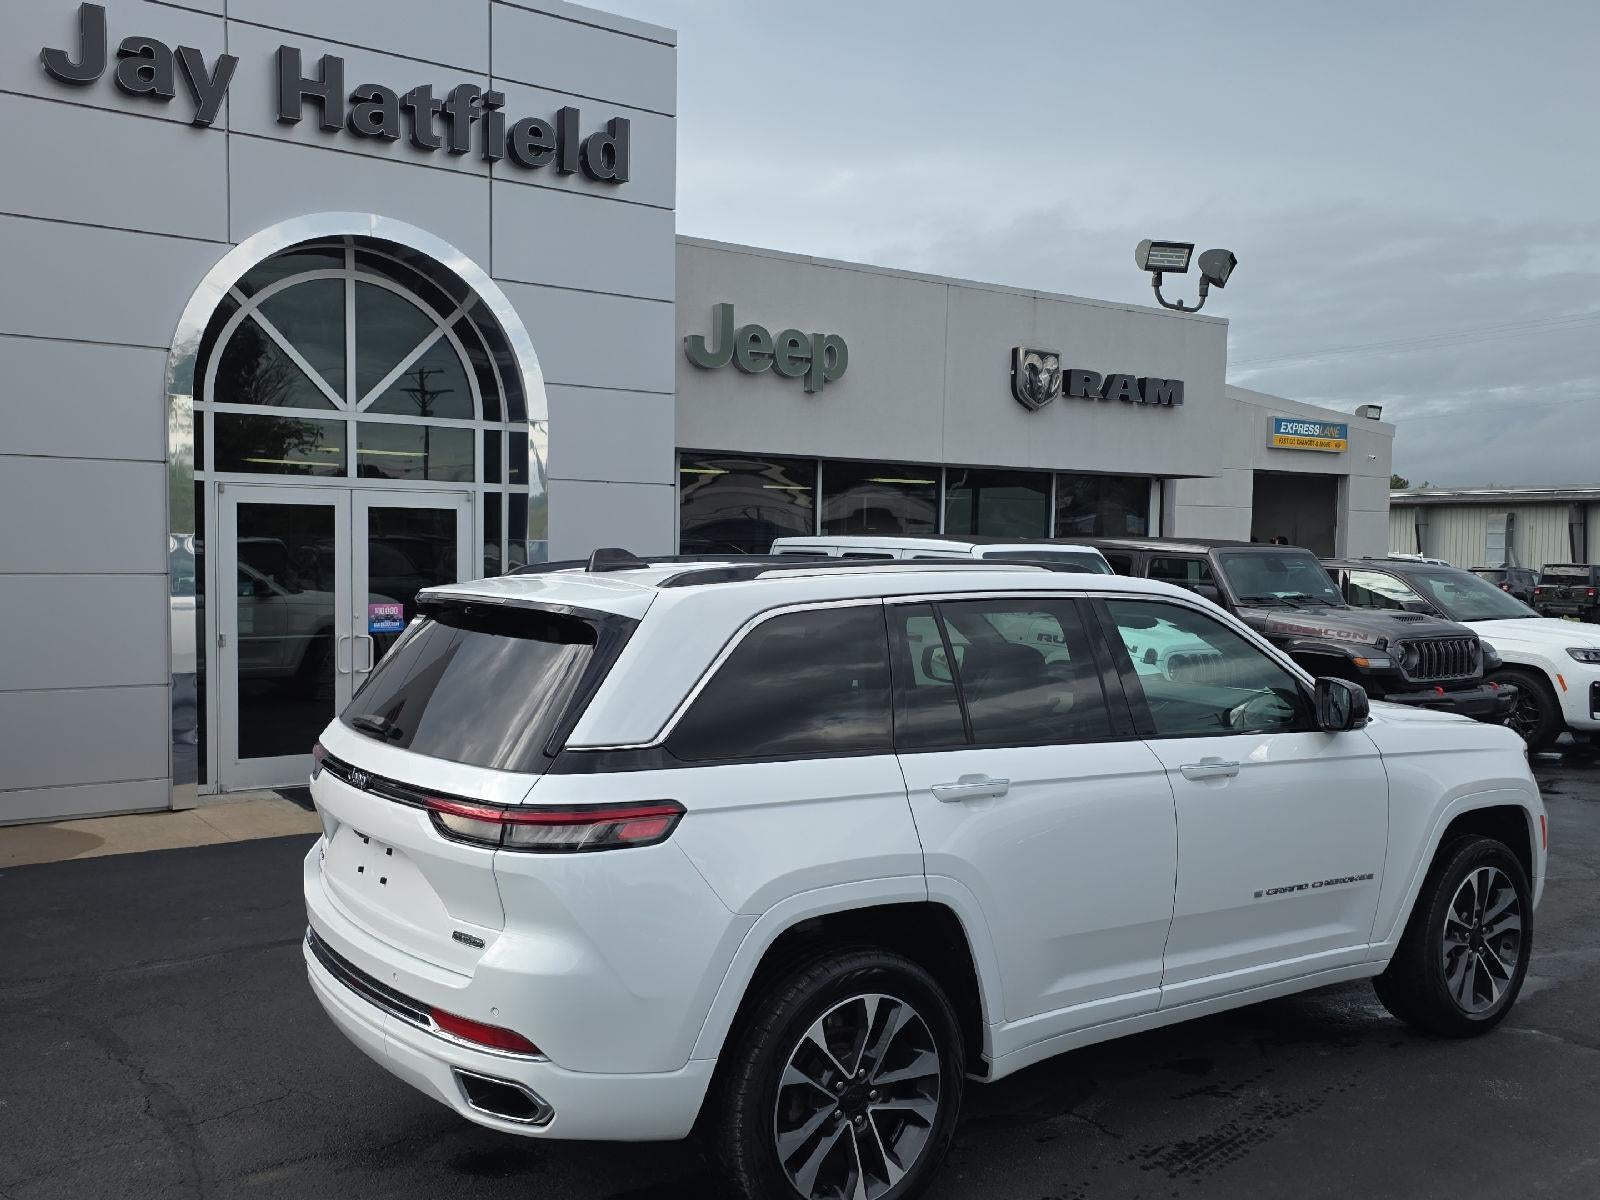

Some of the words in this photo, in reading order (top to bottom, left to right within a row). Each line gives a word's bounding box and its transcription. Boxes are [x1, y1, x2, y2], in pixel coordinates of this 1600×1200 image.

[40, 2, 239, 128] Jay
[275, 44, 631, 185] Hatfield
[684, 303, 849, 393] Jeep
[1062, 368, 1184, 406] RAM
[1273, 623, 1369, 640] RUBICON
[1265, 883, 1309, 896] GRAND
[1311, 872, 1374, 888] CHEROKEE
